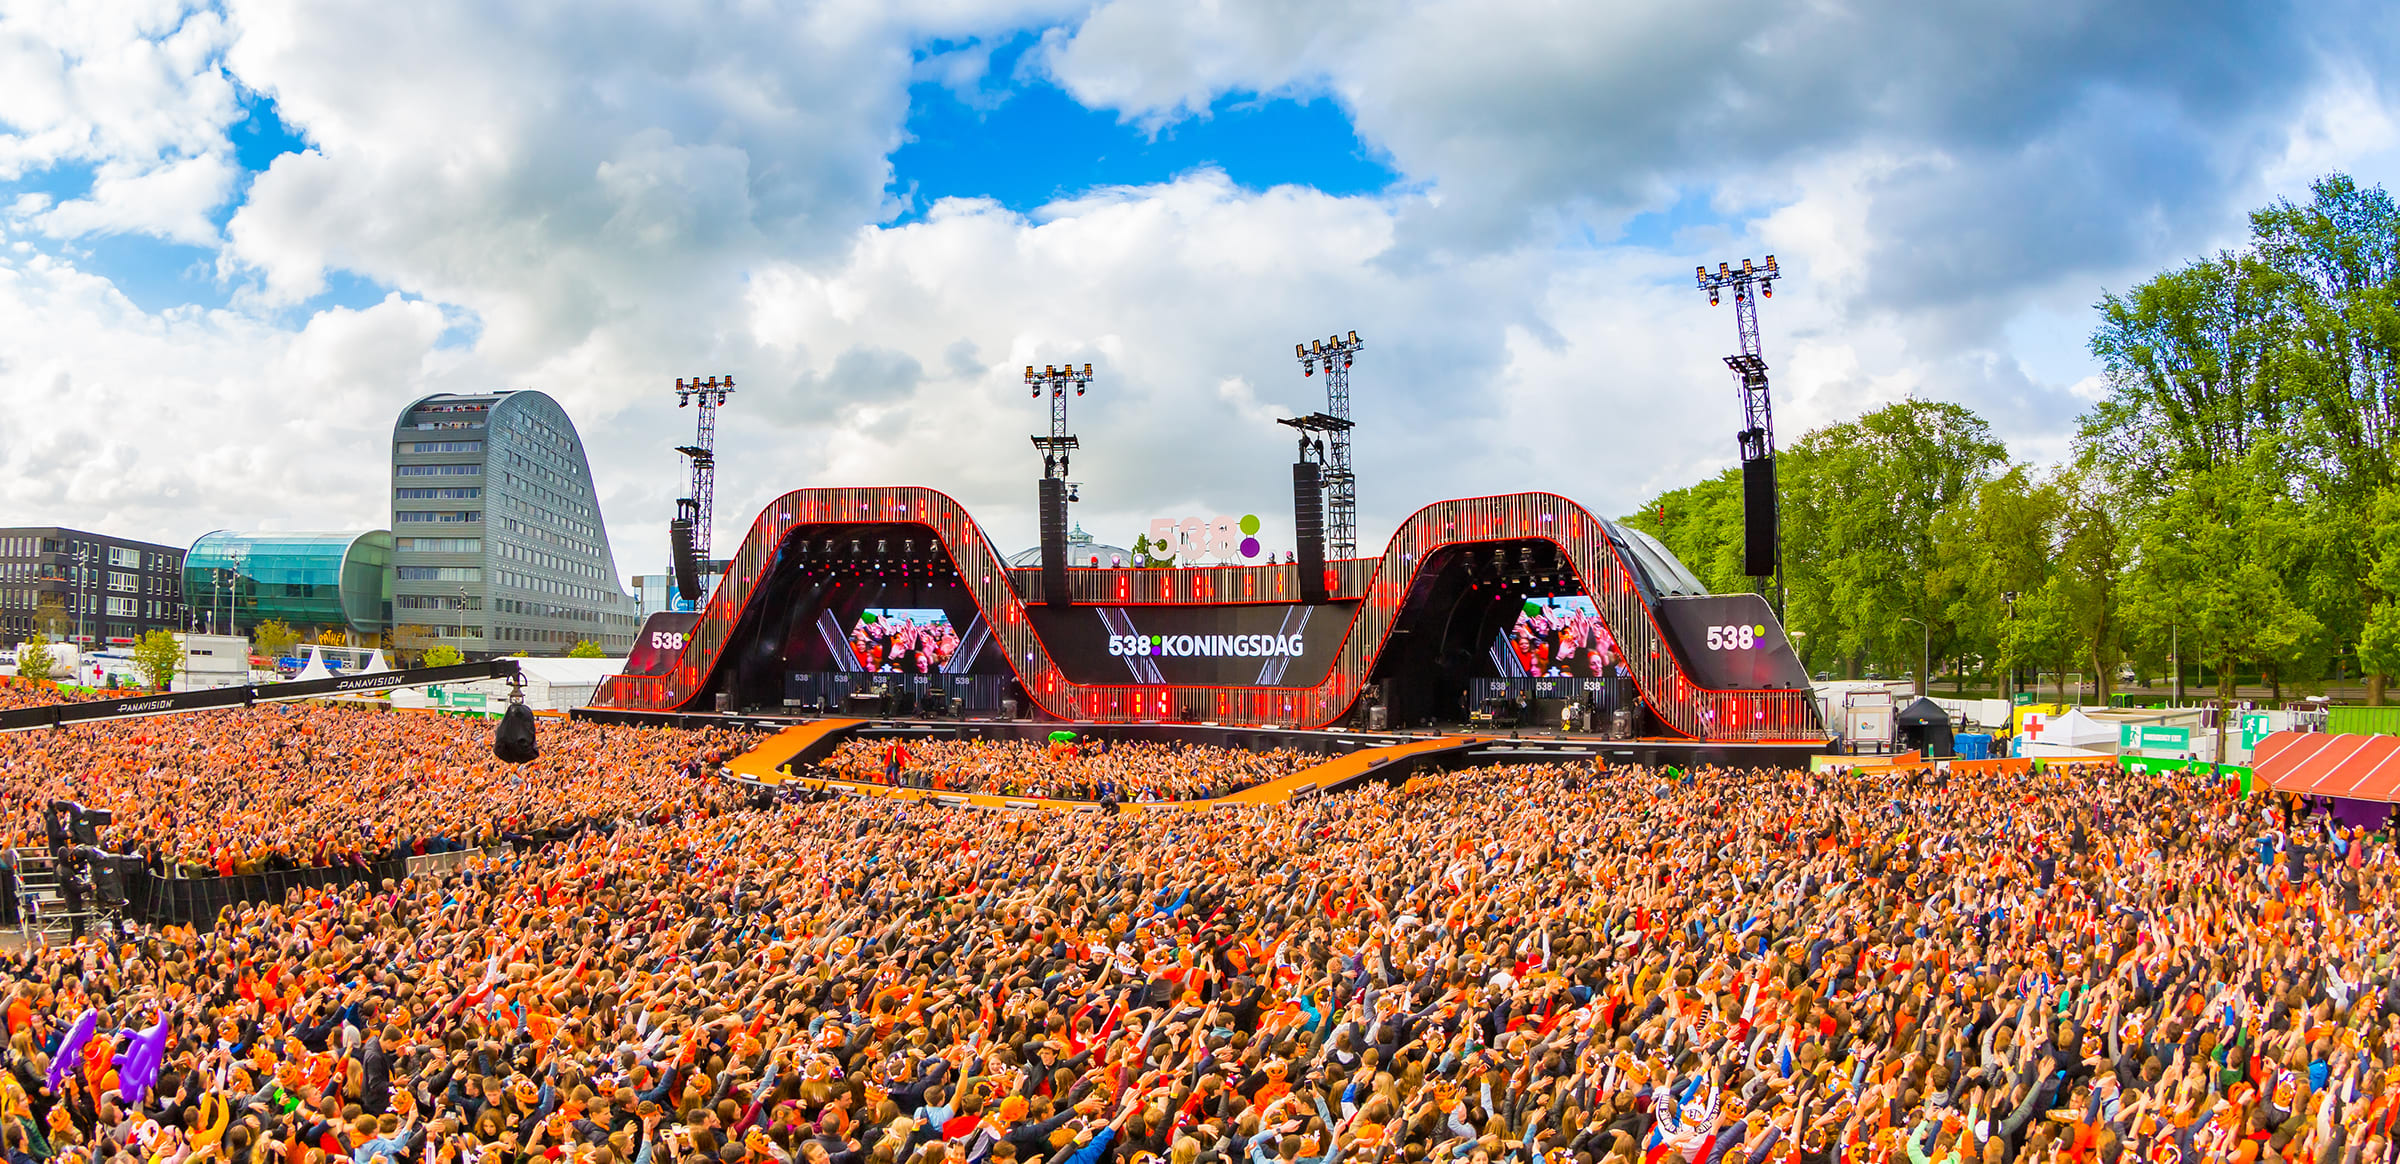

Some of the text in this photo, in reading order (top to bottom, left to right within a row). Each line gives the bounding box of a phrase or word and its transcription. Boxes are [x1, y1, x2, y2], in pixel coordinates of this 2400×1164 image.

[1148, 516, 1238, 560] 538
[651, 631, 683, 650] 538
[1706, 624, 1754, 651] 538
[794, 673, 809, 682] 538
[834, 674, 849, 683] 538
[872, 675, 887, 683] 538
[913, 676, 928, 684] 538
[955, 677, 970, 685] 538
[336, 675, 405, 690] PANAVISION
[1490, 682, 1506, 690] 538
[1536, 682, 1552, 691] 538
[1583, 681, 1601, 691] 538
[117, 699, 175, 713] PANAVISION
